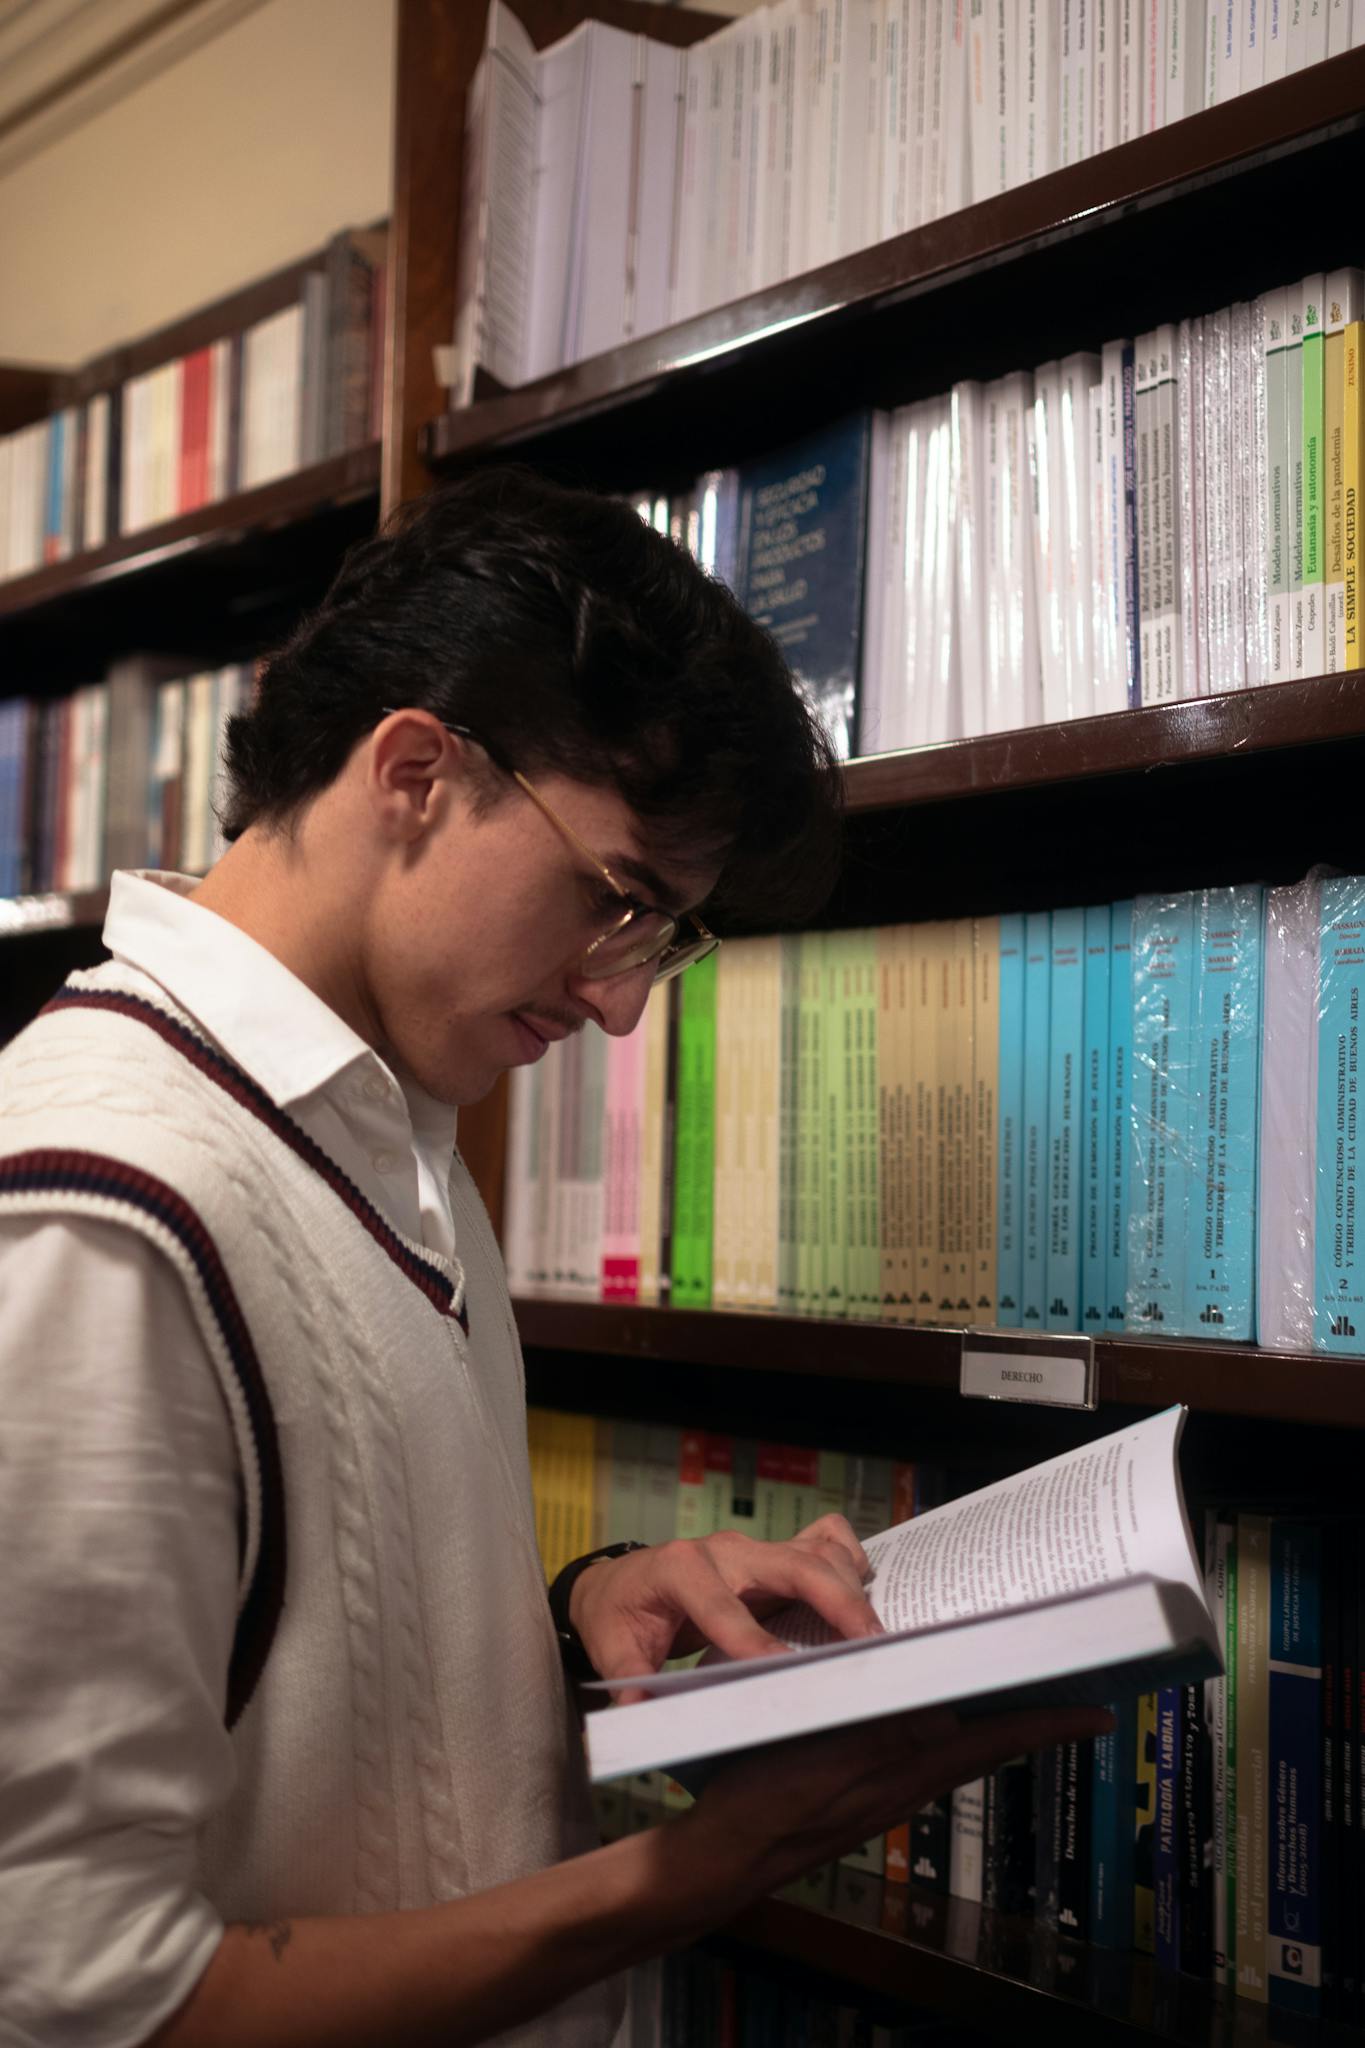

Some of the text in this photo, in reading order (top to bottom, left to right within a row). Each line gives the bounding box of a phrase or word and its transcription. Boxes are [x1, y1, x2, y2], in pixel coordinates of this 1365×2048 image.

[1162, 424, 1170, 476] humanos
[1163, 478, 1171, 529] derechos
[1273, 466, 1281, 532] normativos
[1332, 427, 1343, 572] Desafíos de la pandemia
[1307, 437, 1317, 631] Céspedes Eutanasia y autonomía
[1347, 488, 1355, 560] SOCIEDAD
[1164, 542, 1172, 559] law
[1164, 565, 1172, 576] of
[1273, 535, 1281, 584] Modelos
[1164, 579, 1172, 605] Rule
[1347, 566, 1355, 620] SIMPLE
[1274, 604, 1282, 631] Zapata
[1347, 626, 1355, 644] LA
[1295, 631, 1303, 668] Moncada
[1328, 635, 1337, 673] bbi-Baldi
[1223, 992, 1231, 1025] AIRES
[1350, 987, 1358, 1021] AIRES
[1221, 1029, 1230, 1073] BUENOS
[1349, 1026, 1358, 1072] BUENOS
[1092, 1097, 1098, 1112] DE
[1116, 1096, 1122, 1110] DE
[1161, 1083, 1167, 1096] DE
[1221, 1079, 1228, 1093] DE
[1349, 1077, 1357, 1092] DE
[1219, 1098, 1227, 1139] CIUDAD
[1348, 1098, 1356, 1141] CIUDAD
[1003, 1117, 1012, 1178] POLÍTICO
[1028, 1126, 1037, 1188] POLÍTICO
[1061, 1053, 1071, 1255] DE LOS DERECHOS HUMANOS
[1089, 1118, 1098, 1178] REMOCIÓN
[1114, 1116, 1122, 1177] REMOCIÓN
[1159, 1147, 1165, 1158] LA
[1203, 1038, 1218, 1259] CÓDIGO CONTENCIOSO ADMINISTRATIVO
[1219, 1144, 1226, 1157] LA
[1334, 1035, 1346, 1268] CÓDIGO CONTENCIOSO ADMINISTRATIVO
[1348, 1146, 1356, 1160] LA
[1148, 1138, 1156, 1212] CONTENCIOSO
[1158, 1166, 1165, 1177] DE
[1218, 1162, 1225, 1177] DE
[1347, 1165, 1355, 1181] DE
[1003, 1184, 1012, 1226] JUICIO
[1090, 1184, 1097, 1200] DE
[1114, 1183, 1120, 1199] DE
[1029, 1193, 1037, 1237] JUICIO
[1052, 1205, 1060, 1254] TEORÍA
[1216, 1181, 1225, 1246] TRIBUTARIO
[1346, 1186, 1355, 1255] TRIBUTARIO
[1150, 1268, 1158, 1278] 2
[1211, 1269, 1215, 1279] 1
[1339, 1279, 1348, 1289] 2
[1001, 1370, 1043, 1383] DERECHO
[1216, 1558, 1224, 1598] CADHU
[1248, 1622, 1256, 1684] FERNÁNDEZ
[1293, 1631, 1299, 1642] DE
[1216, 1732, 1223, 1743] al
[1159, 1710, 1173, 1853] PATOLOGÍA LABORAL
[1185, 1734, 1193, 1808] extorsivo
[1190, 1722, 1199, 1732] y
[1065, 1740, 1077, 1860] Derecho de tránsi
[1250, 1748, 1265, 1941] en el proceso comercial
[1276, 1760, 1287, 1891] Informe sobre Género
[1237, 1816, 1248, 1935] Vulnerabilidad
[1288, 1827, 1297, 1883] Derechos
[1289, 1885, 1297, 1894] y
